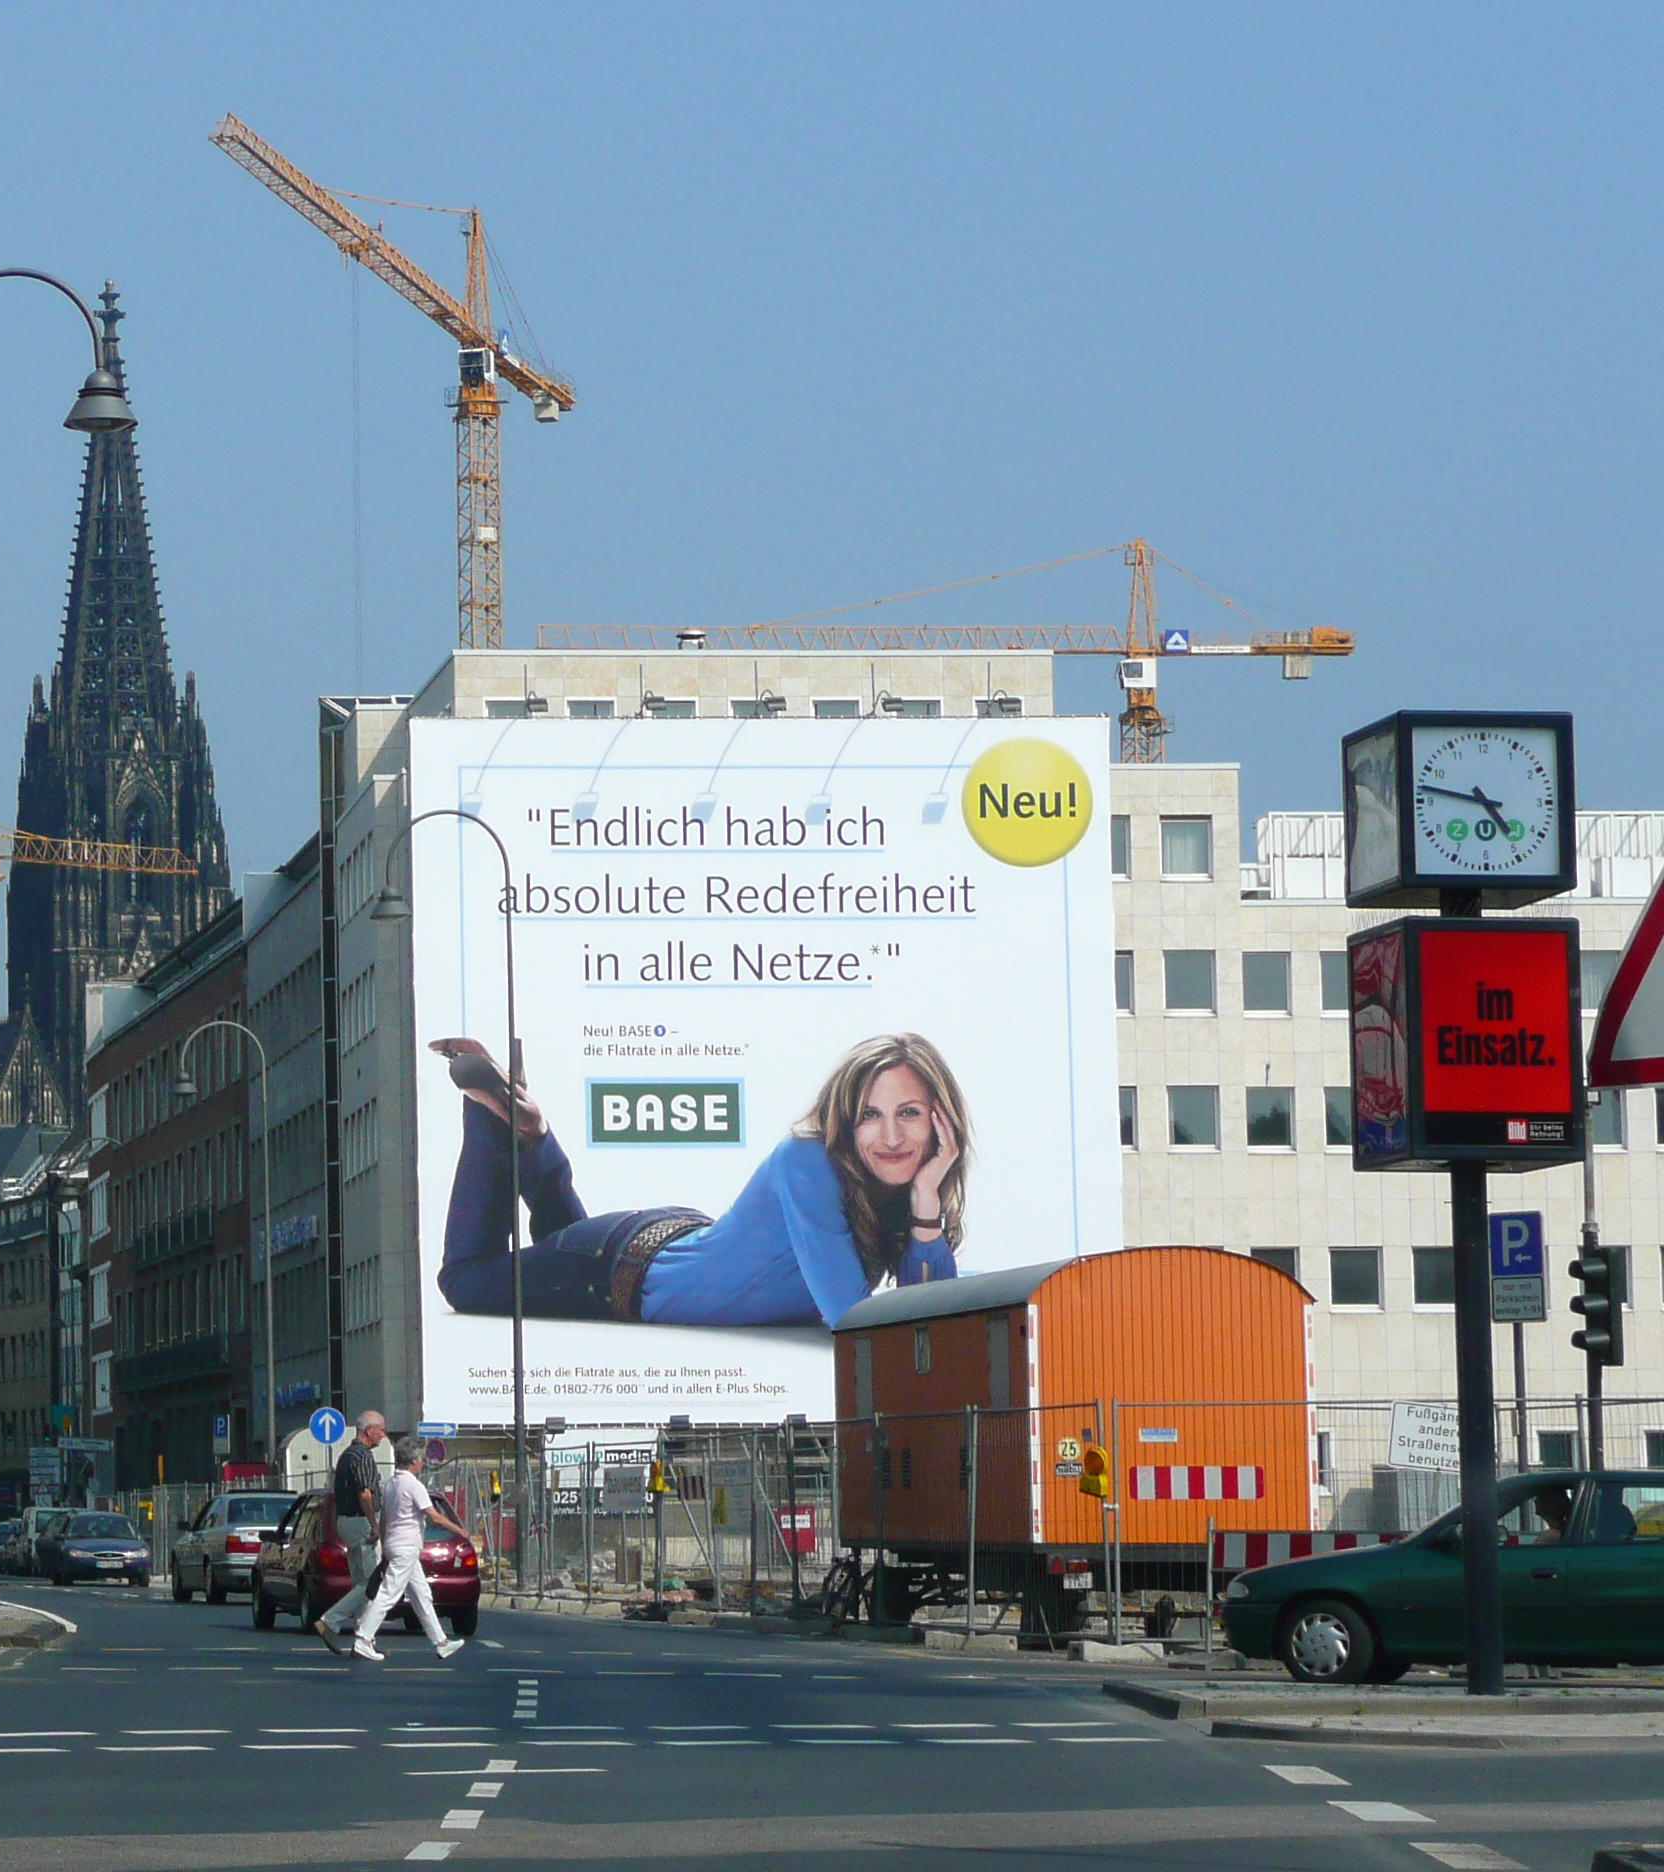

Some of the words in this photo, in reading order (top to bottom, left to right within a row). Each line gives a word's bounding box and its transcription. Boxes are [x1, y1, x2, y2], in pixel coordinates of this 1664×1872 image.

[1453, 751, 1462, 760] 11
[1478, 744, 1489, 754] 12
[1434, 769, 1445, 779] 10
[1527, 770, 1533, 780] 2
[979, 782, 1077, 819] Neu!
[1427, 797, 1434, 806] 9
[1536, 798, 1542, 808] 3
[527, 805, 705, 847] "Endlich
[726, 805, 807, 847] hab
[825, 805, 885, 847] ich
[1479, 823, 1491, 837] U
[1529, 825, 1536, 834] 4
[1455, 843, 1462, 852] 7
[1510, 844, 1517, 853] 5
[1483, 850, 1489, 860] 6
[497, 873, 686, 915] absolute
[706, 872, 976, 914] Redefreiheit
[584, 943, 619, 982] in
[639, 940, 713, 982] alle
[1476, 981, 1514, 1021] im
[583, 1025, 613, 1037] Neu!
[583, 1043, 604, 1056] die
[607, 1043, 657, 1057] Flatrate
[661, 1044, 673, 1056] in
[676, 1043, 700, 1056] alle
[1437, 1024, 1556, 1067] Einsatz.
[602, 1094, 729, 1132] BASE
[1501, 1219, 1530, 1267] P
[467, 1366, 507, 1379] Suchen
[529, 1366, 552, 1378] sich
[554, 1366, 571, 1378] die
[574, 1366, 616, 1378] Flatrate
[618, 1369, 640, 1379] aus,
[644, 1366, 661, 1378] die
[664, 1369, 677, 1378] zu
[680, 1366, 711, 1378] Ihnen
[714, 1366, 747, 1380] passt.
[553, 1383, 614, 1395] 01802-776
[648, 1383, 669, 1395] und
[672, 1383, 683, 1394] in
[686, 1382, 713, 1394] allen
[752, 1381, 789, 1396] Shops.
[1407, 1406, 1459, 1424] Fußgän
[217, 1417, 226, 1434] P
[1418, 1424, 1459, 1438] ander
[1061, 1441, 1077, 1457] 25
[1397, 1435, 1460, 1453] Straßens
